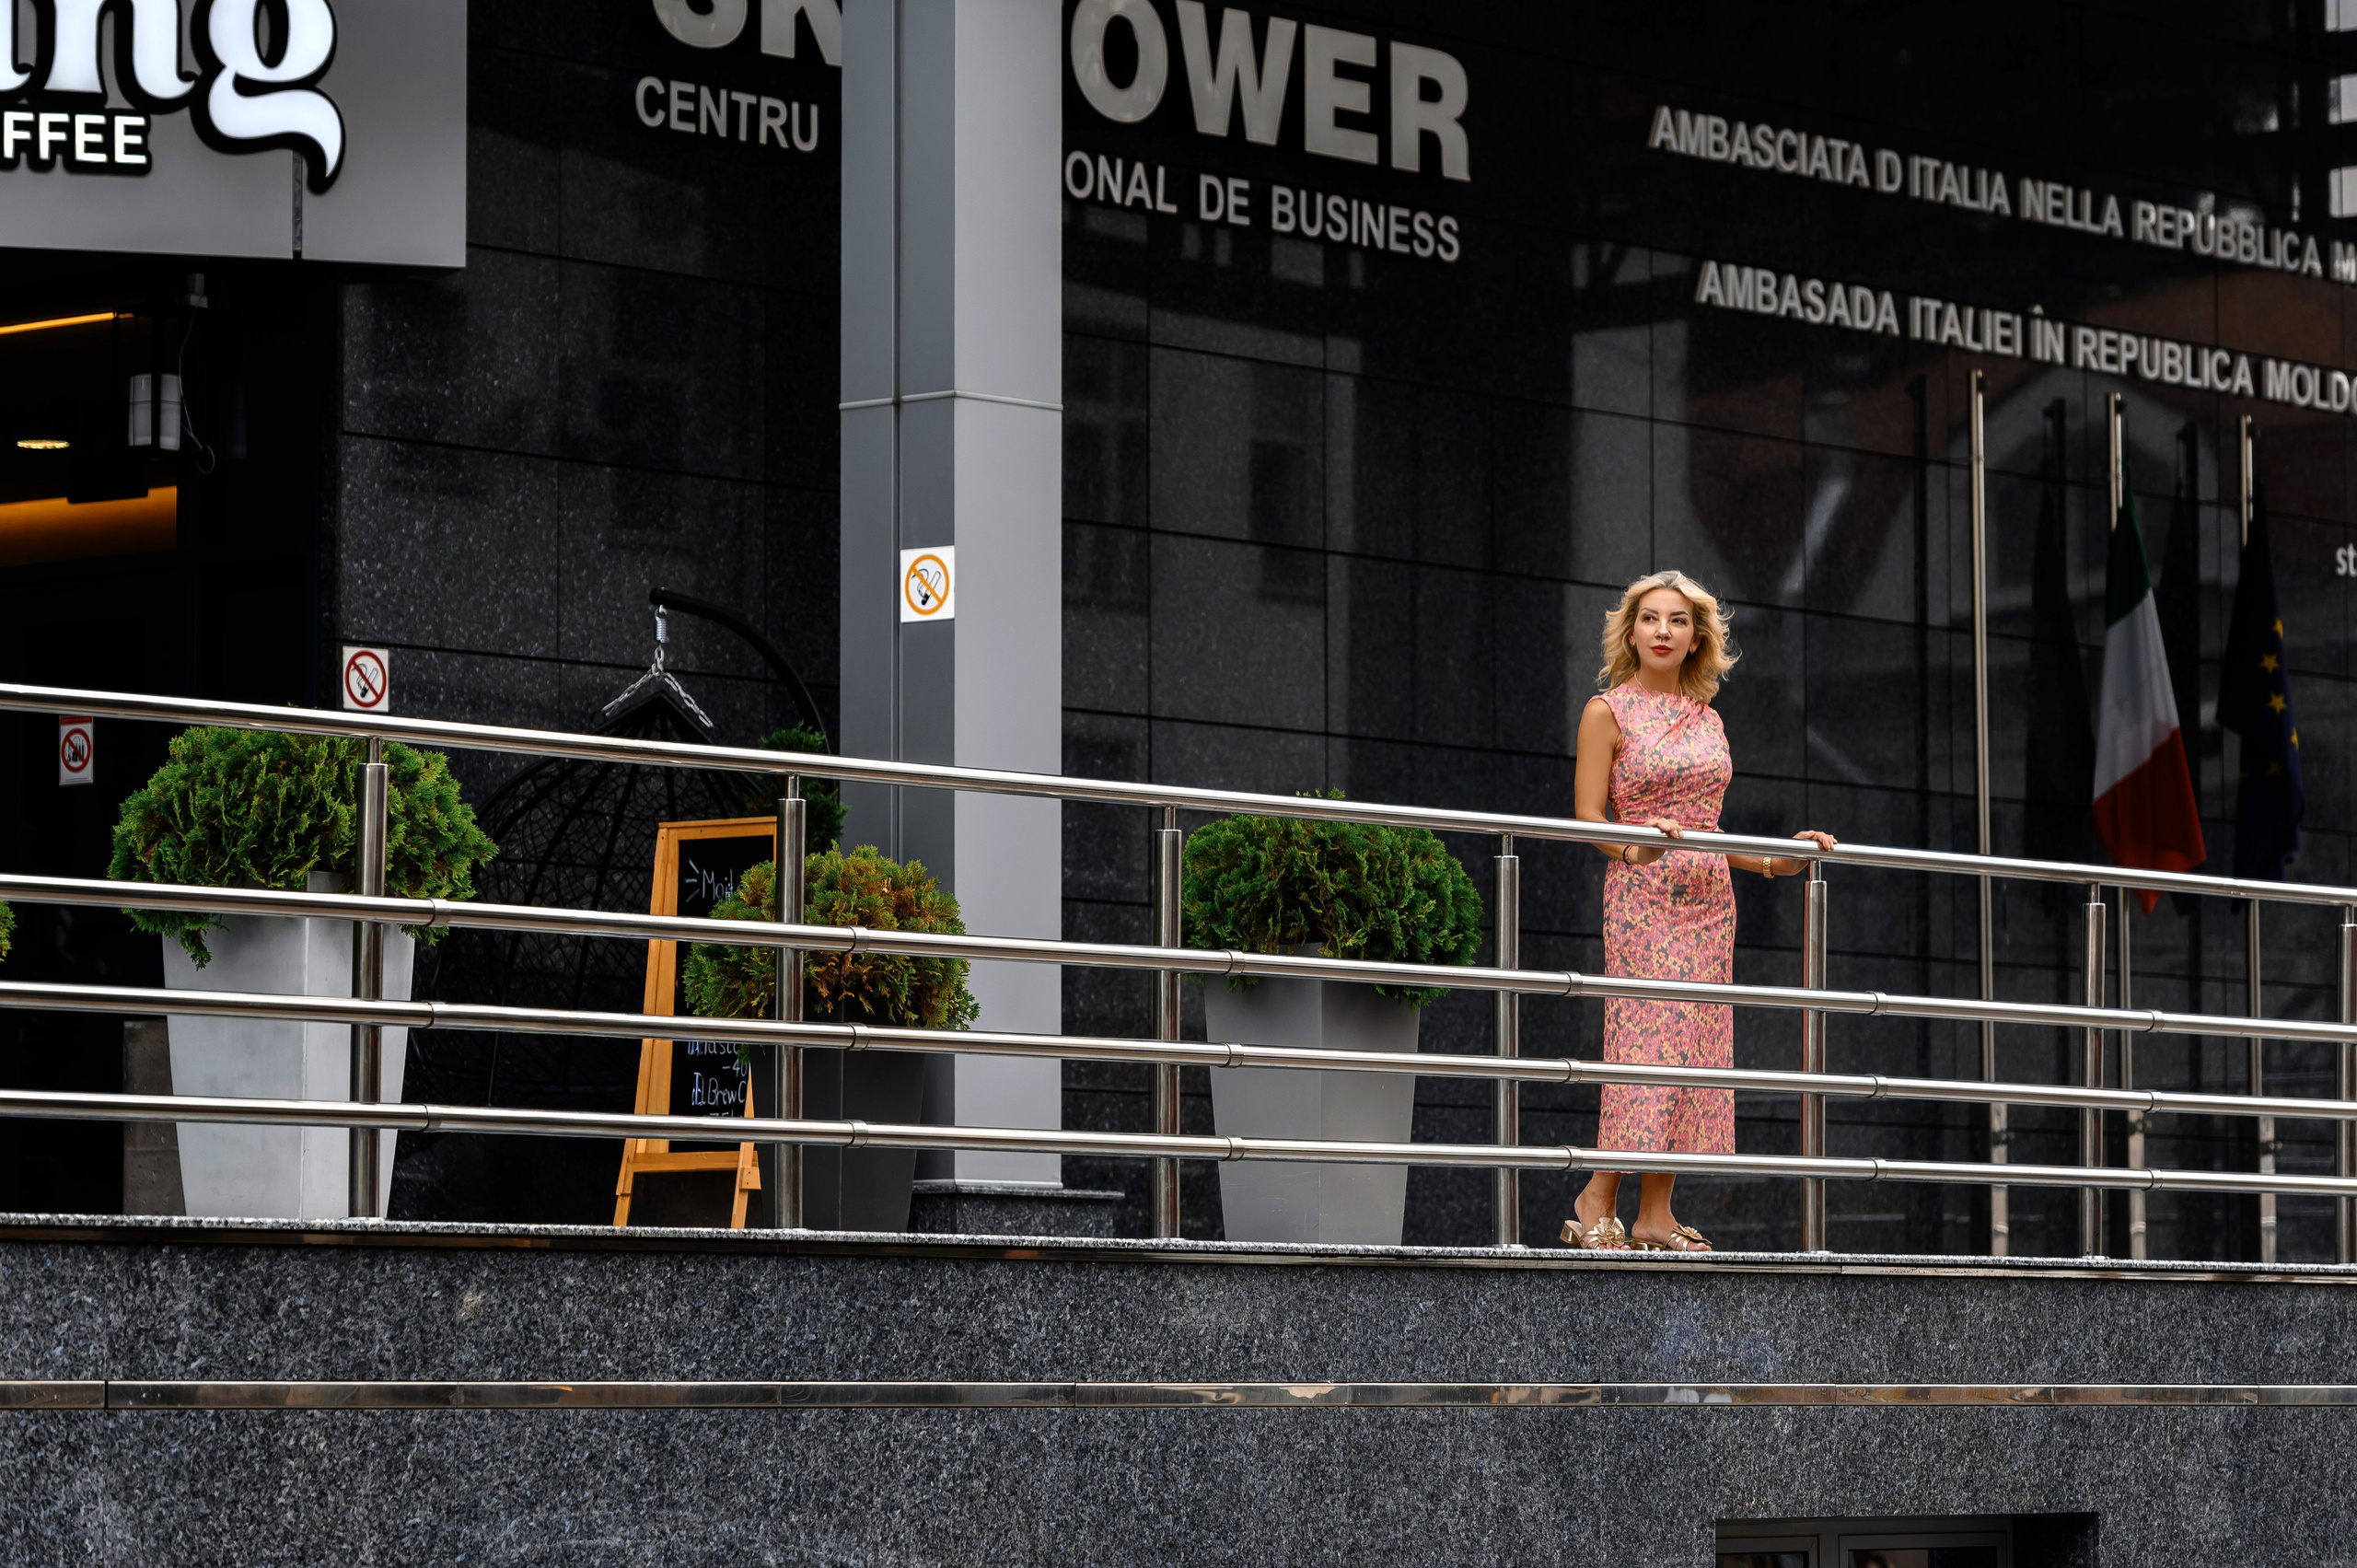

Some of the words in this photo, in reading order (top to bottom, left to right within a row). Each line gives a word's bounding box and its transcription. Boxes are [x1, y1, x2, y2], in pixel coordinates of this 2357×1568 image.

[3, 110, 148, 165] FFEE
[635, 75, 819, 152] CENTRU
[1200, 174, 1250, 226] DE
[1271, 185, 1461, 263] BUSINESS
[1648, 105, 1870, 188] AMBASCIATA
[1909, 155, 2012, 215] ITALIA
[2020, 177, 2124, 238] NELLA
[2131, 200, 2323, 277] REPUBBLICA
[1695, 260, 1900, 337] AMBASADA
[1909, 296, 2023, 357] ITALIEI
[2028, 303, 2065, 365] ÎN
[2073, 325, 2255, 398] REPUBLICA
[2262, 358, 2357, 417] MOLD
